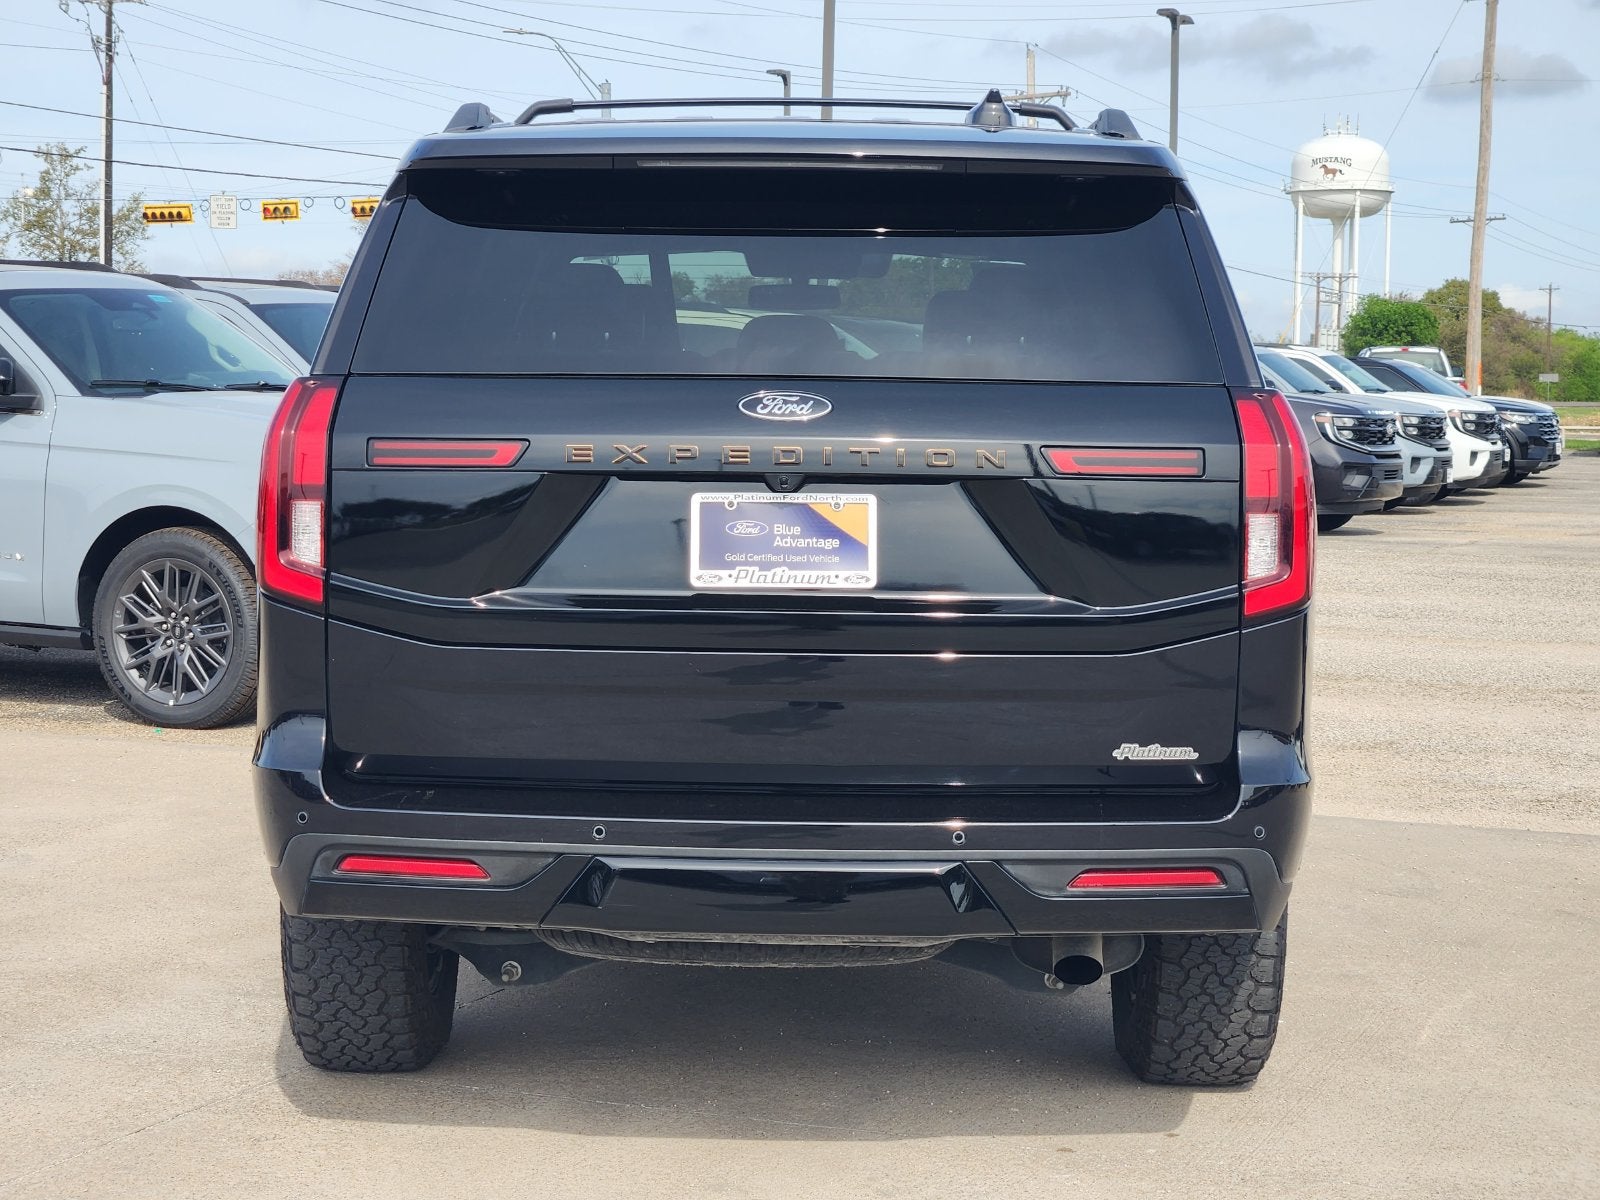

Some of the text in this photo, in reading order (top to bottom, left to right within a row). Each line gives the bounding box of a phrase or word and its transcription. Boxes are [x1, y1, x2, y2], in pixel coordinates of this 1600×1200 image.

[1311, 156, 1352, 167] MUSTANG
[757, 395, 814, 415] Ford
[564, 443, 1008, 470] EXPEDITION
[700, 493, 869, 502] www.PlatinumFordNorth.com
[733, 522, 761, 534] Ford
[773, 523, 801, 535] Blue
[773, 536, 840, 550] Advantage
[724, 552, 840, 563] Gold Certified Used Vehicle
[734, 569, 837, 584] Platinum
[1112, 743, 1199, 760] Platinum
